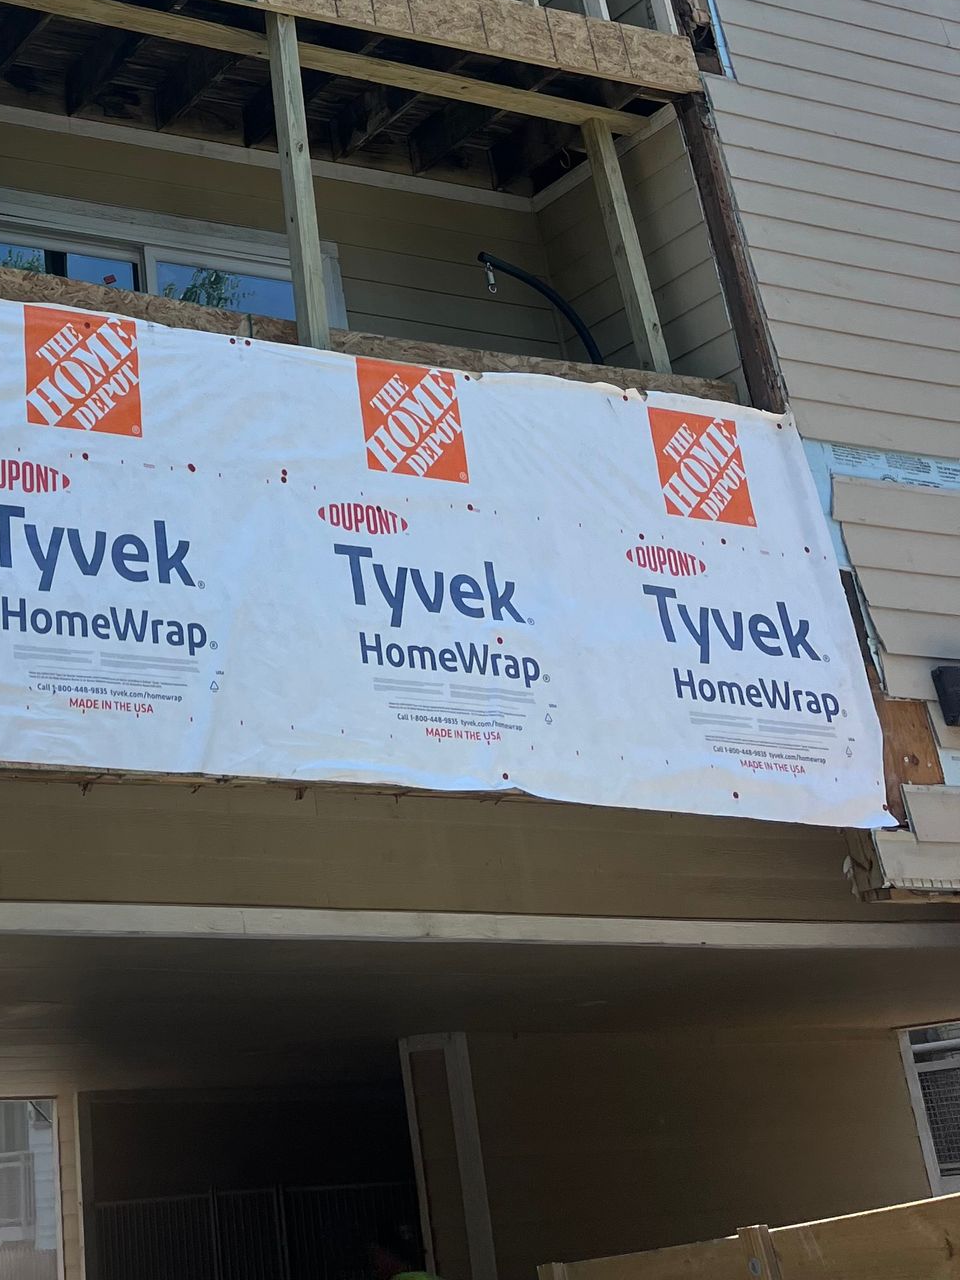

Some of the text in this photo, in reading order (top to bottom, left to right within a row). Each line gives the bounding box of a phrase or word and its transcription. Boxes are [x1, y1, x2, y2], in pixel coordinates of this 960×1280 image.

[36, 322, 83, 366] THE
[26, 317, 139, 426] HOME
[72, 360, 140, 430] DEPOT
[369, 373, 409, 416] THE
[364, 369, 458, 472] HOME
[406, 412, 463, 477] DEPOT
[662, 422, 697, 463] THE
[661, 417, 740, 517] HOME
[699, 459, 747, 521] DEPOT
[329, 503, 398, 534] DUPONT
[333, 543, 526, 628] Tyvek
[636, 545, 698, 577] DUPONT
[1, 596, 207, 656] HomeWrap
[642, 583, 822, 664] Tyvek
[359, 632, 540, 688] HomeWrap
[37, 683, 183, 702] Call 1-800-448-9835 tyvek.com/homewrap
[69, 698, 154, 713] MADE IN THE USA
[397, 713, 409, 721] Call
[672, 667, 840, 723] HomeWrap
[425, 727, 502, 742] MADE IN THE USA
[713, 745, 724, 753] Call
[739, 759, 806, 774] MADE IN THE USA
